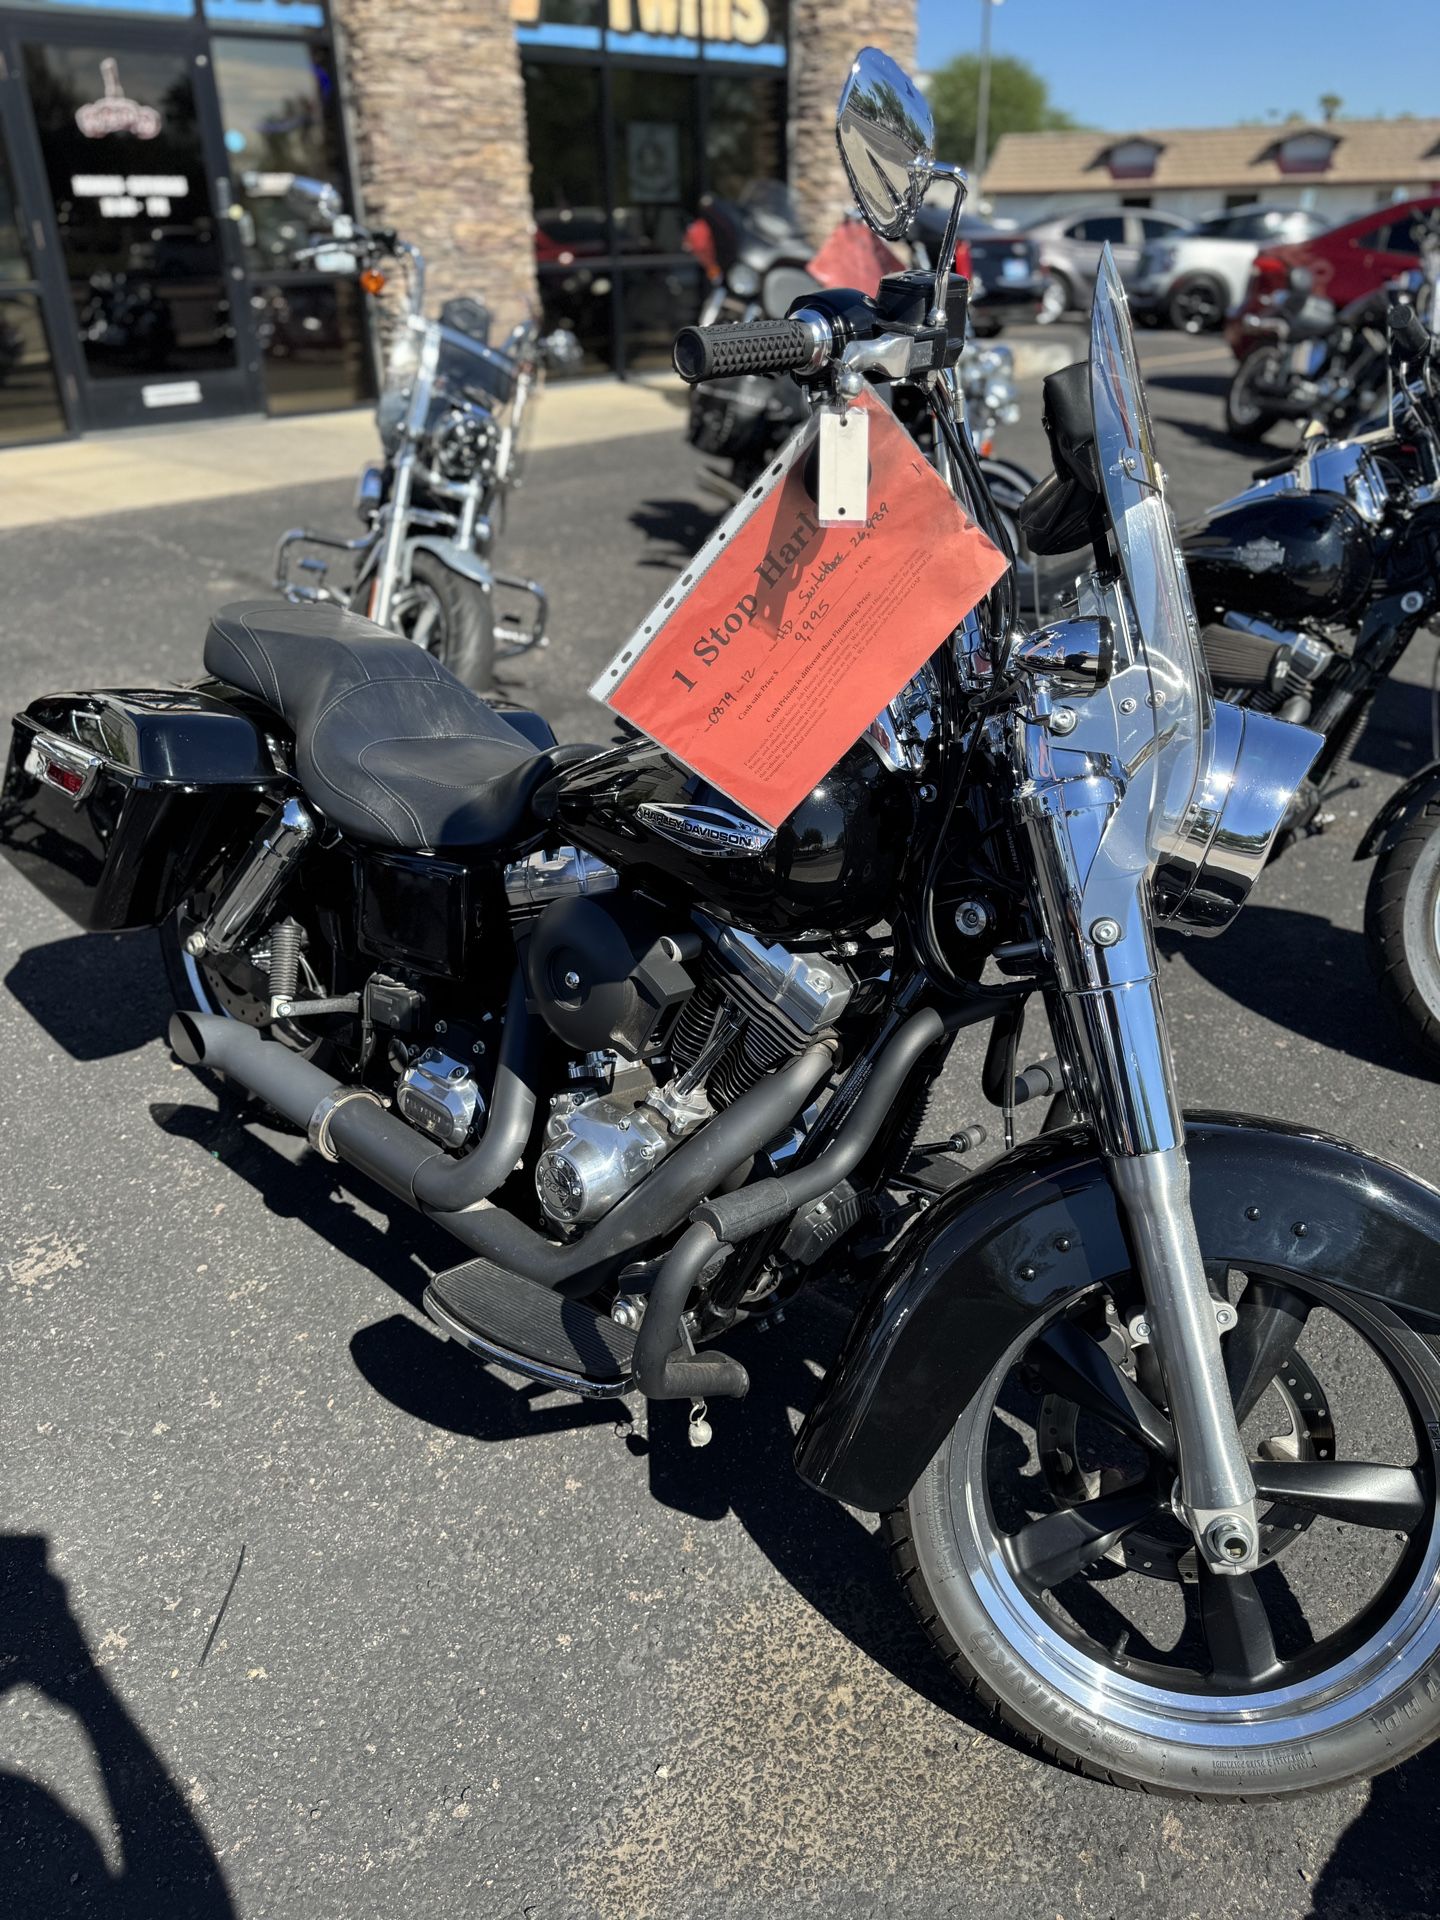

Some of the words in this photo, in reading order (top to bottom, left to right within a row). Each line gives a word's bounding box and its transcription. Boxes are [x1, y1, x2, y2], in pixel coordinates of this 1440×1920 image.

[672, 670, 696, 692] 1
[693, 594, 765, 666] Stop
[753, 510, 823, 590] Harl
[794, 598, 831, 644] 9,995
[706, 692, 735, 723] 0879
[741, 665, 756, 682] 12
[777, 621, 794, 639] HD
[737, 703, 752, 719] Cash
[750, 691, 762, 704] sale
[760, 674, 775, 691] Price
[765, 706, 780, 722] Cash
[778, 684, 798, 707] Pricing
[799, 652, 822, 678] different
[820, 637, 833, 651] than
[832, 607, 859, 638] Financing
[857, 591, 871, 607] Price
[643, 809, 752, 847] HARLEY-DAVIDSON
[970, 1631, 1098, 1740] SHINKO
